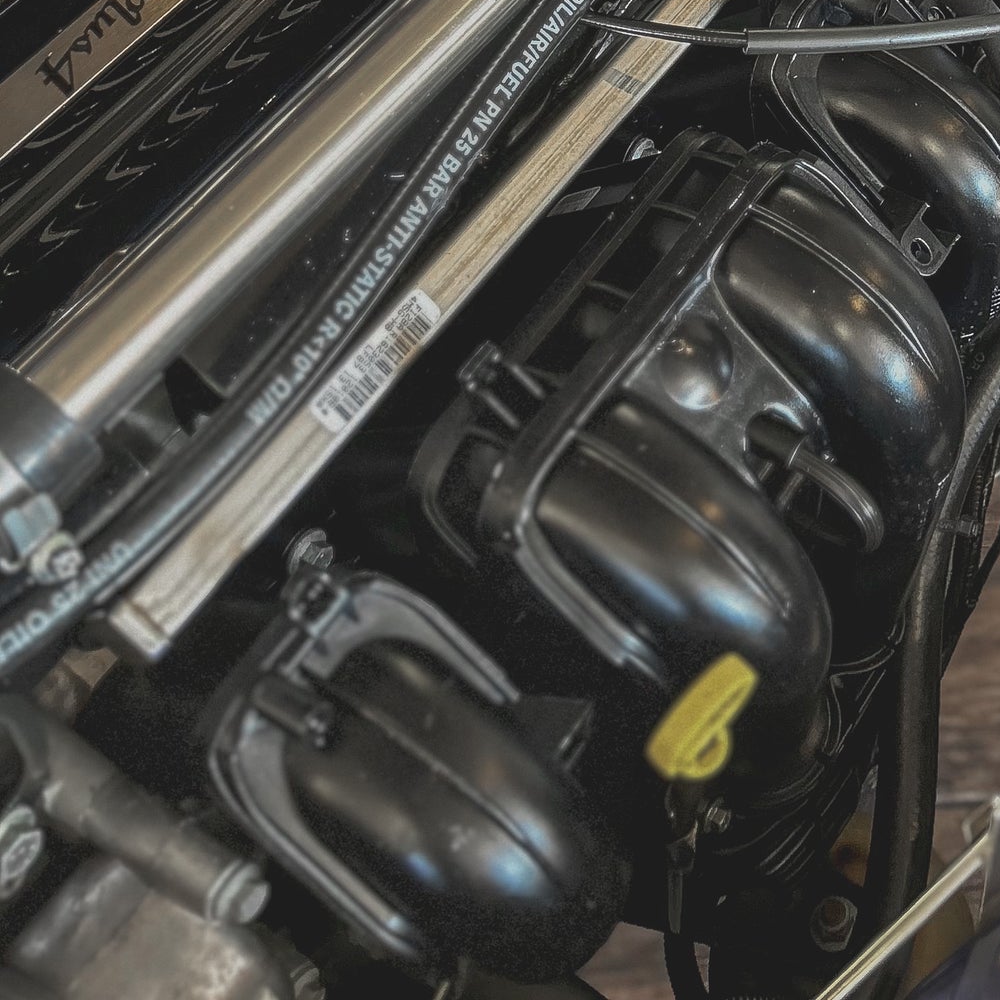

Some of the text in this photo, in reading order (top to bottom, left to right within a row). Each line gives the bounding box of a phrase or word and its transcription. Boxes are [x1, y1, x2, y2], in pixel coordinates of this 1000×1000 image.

[470, 98, 502, 131] PN
[453, 126, 480, 156] 25
[421, 153, 461, 199] BAR
[330, 195, 431, 321] ANTI-STATIC
